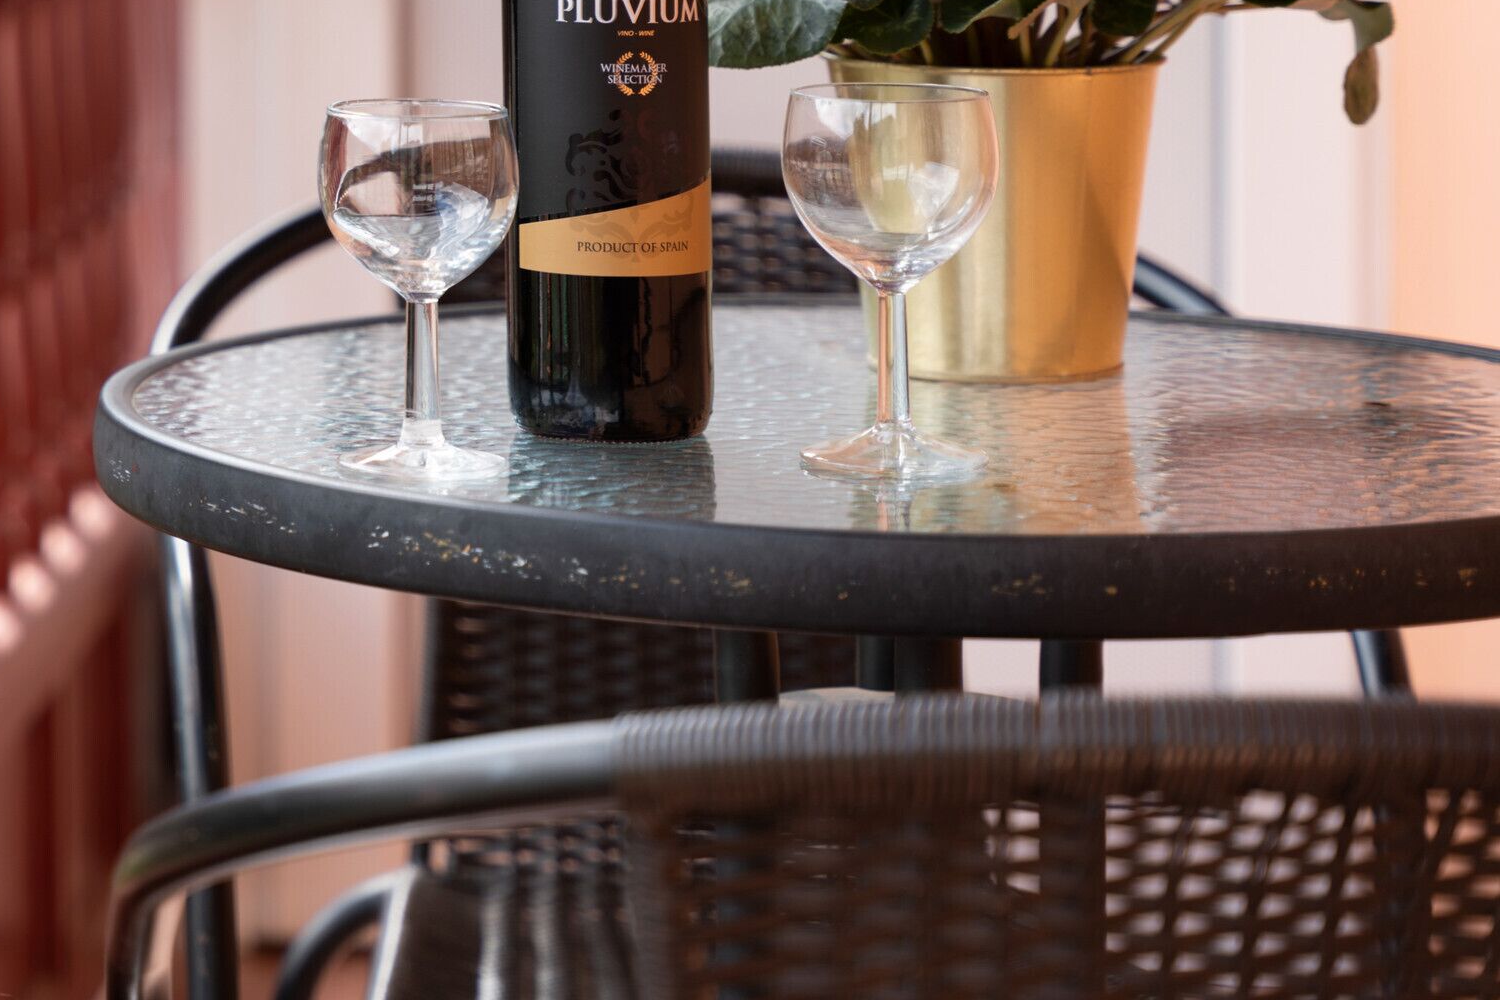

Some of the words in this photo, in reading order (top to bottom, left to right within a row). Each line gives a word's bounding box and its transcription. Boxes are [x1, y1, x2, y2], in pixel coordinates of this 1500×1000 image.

[600, 63, 668, 73] WINEMAKER
[607, 74, 663, 85] SELECTION
[577, 241, 638, 253] PRODUCT
[641, 242, 657, 253] OF
[660, 240, 688, 252] SPAIN
